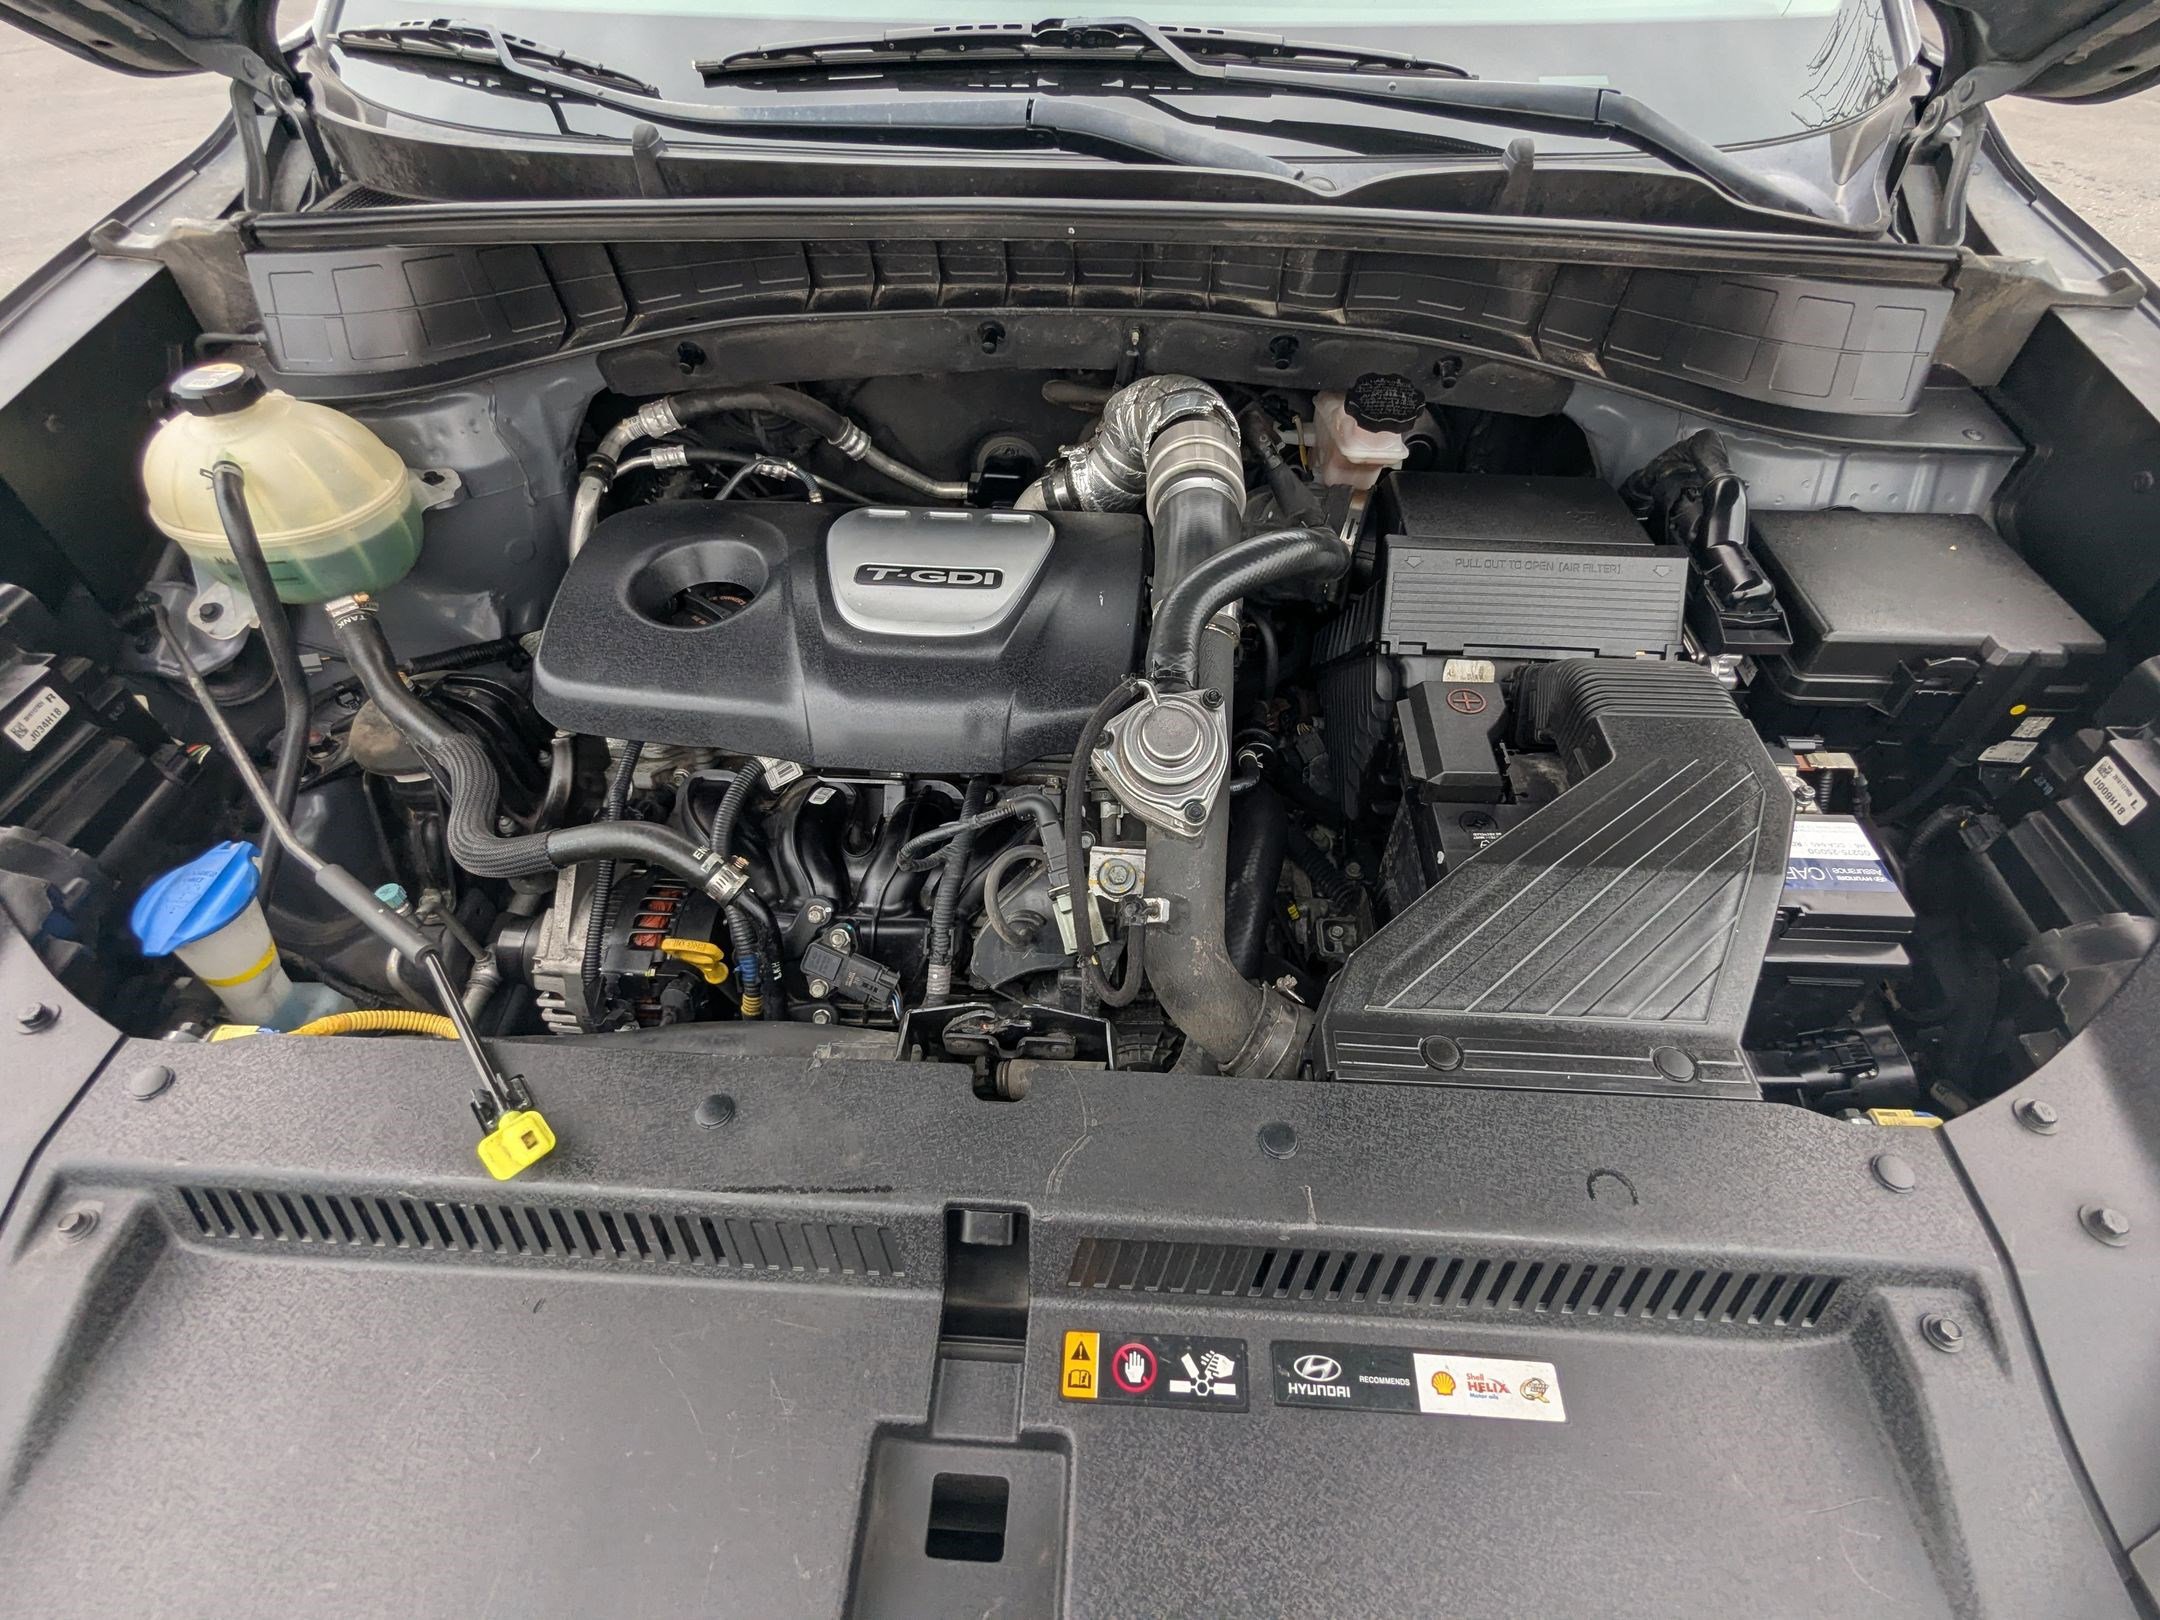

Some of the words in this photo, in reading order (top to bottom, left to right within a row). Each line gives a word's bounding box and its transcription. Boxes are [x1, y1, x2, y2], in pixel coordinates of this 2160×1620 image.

[1455, 558, 1482, 569] PULL
[1484, 559, 1506, 570] OUT
[1508, 560, 1522, 570] TO
[1524, 560, 1554, 571] OPEN
[866, 567, 995, 585] T-GDI
[337, 614, 367, 629] TANK
[45, 693, 56, 703] R
[2130, 799, 2138, 810] L
[1831, 867, 1882, 876] Assurance
[1358, 1375, 1410, 1386] RECOMMENDS
[1466, 1373, 1485, 1381] Shell
[1288, 1382, 1351, 1398] HYUNDAI
[1467, 1379, 1511, 1394] HELIX
